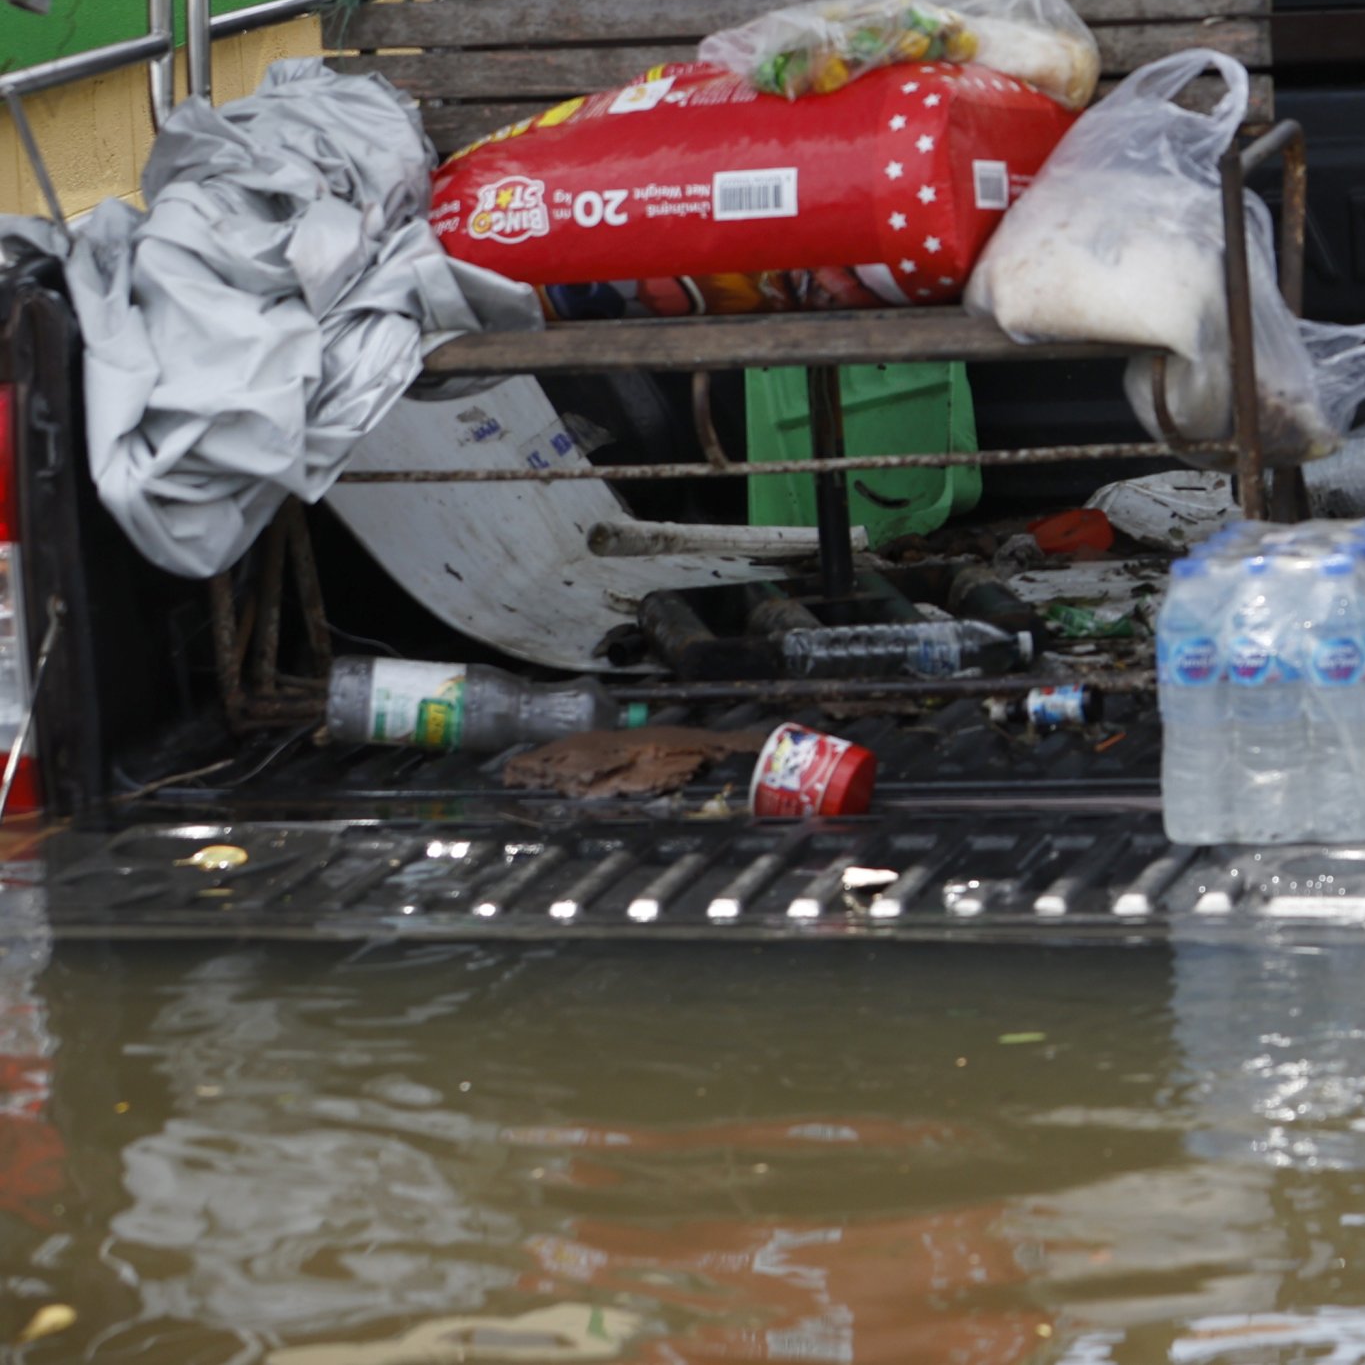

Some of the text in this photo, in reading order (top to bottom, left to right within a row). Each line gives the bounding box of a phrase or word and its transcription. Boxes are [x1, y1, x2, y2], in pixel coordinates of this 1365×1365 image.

[553, 190, 572, 205] kg
[634, 183, 711, 200] Net Weight
[573, 189, 629, 228] 20
[471, 209, 543, 236] BINGO
